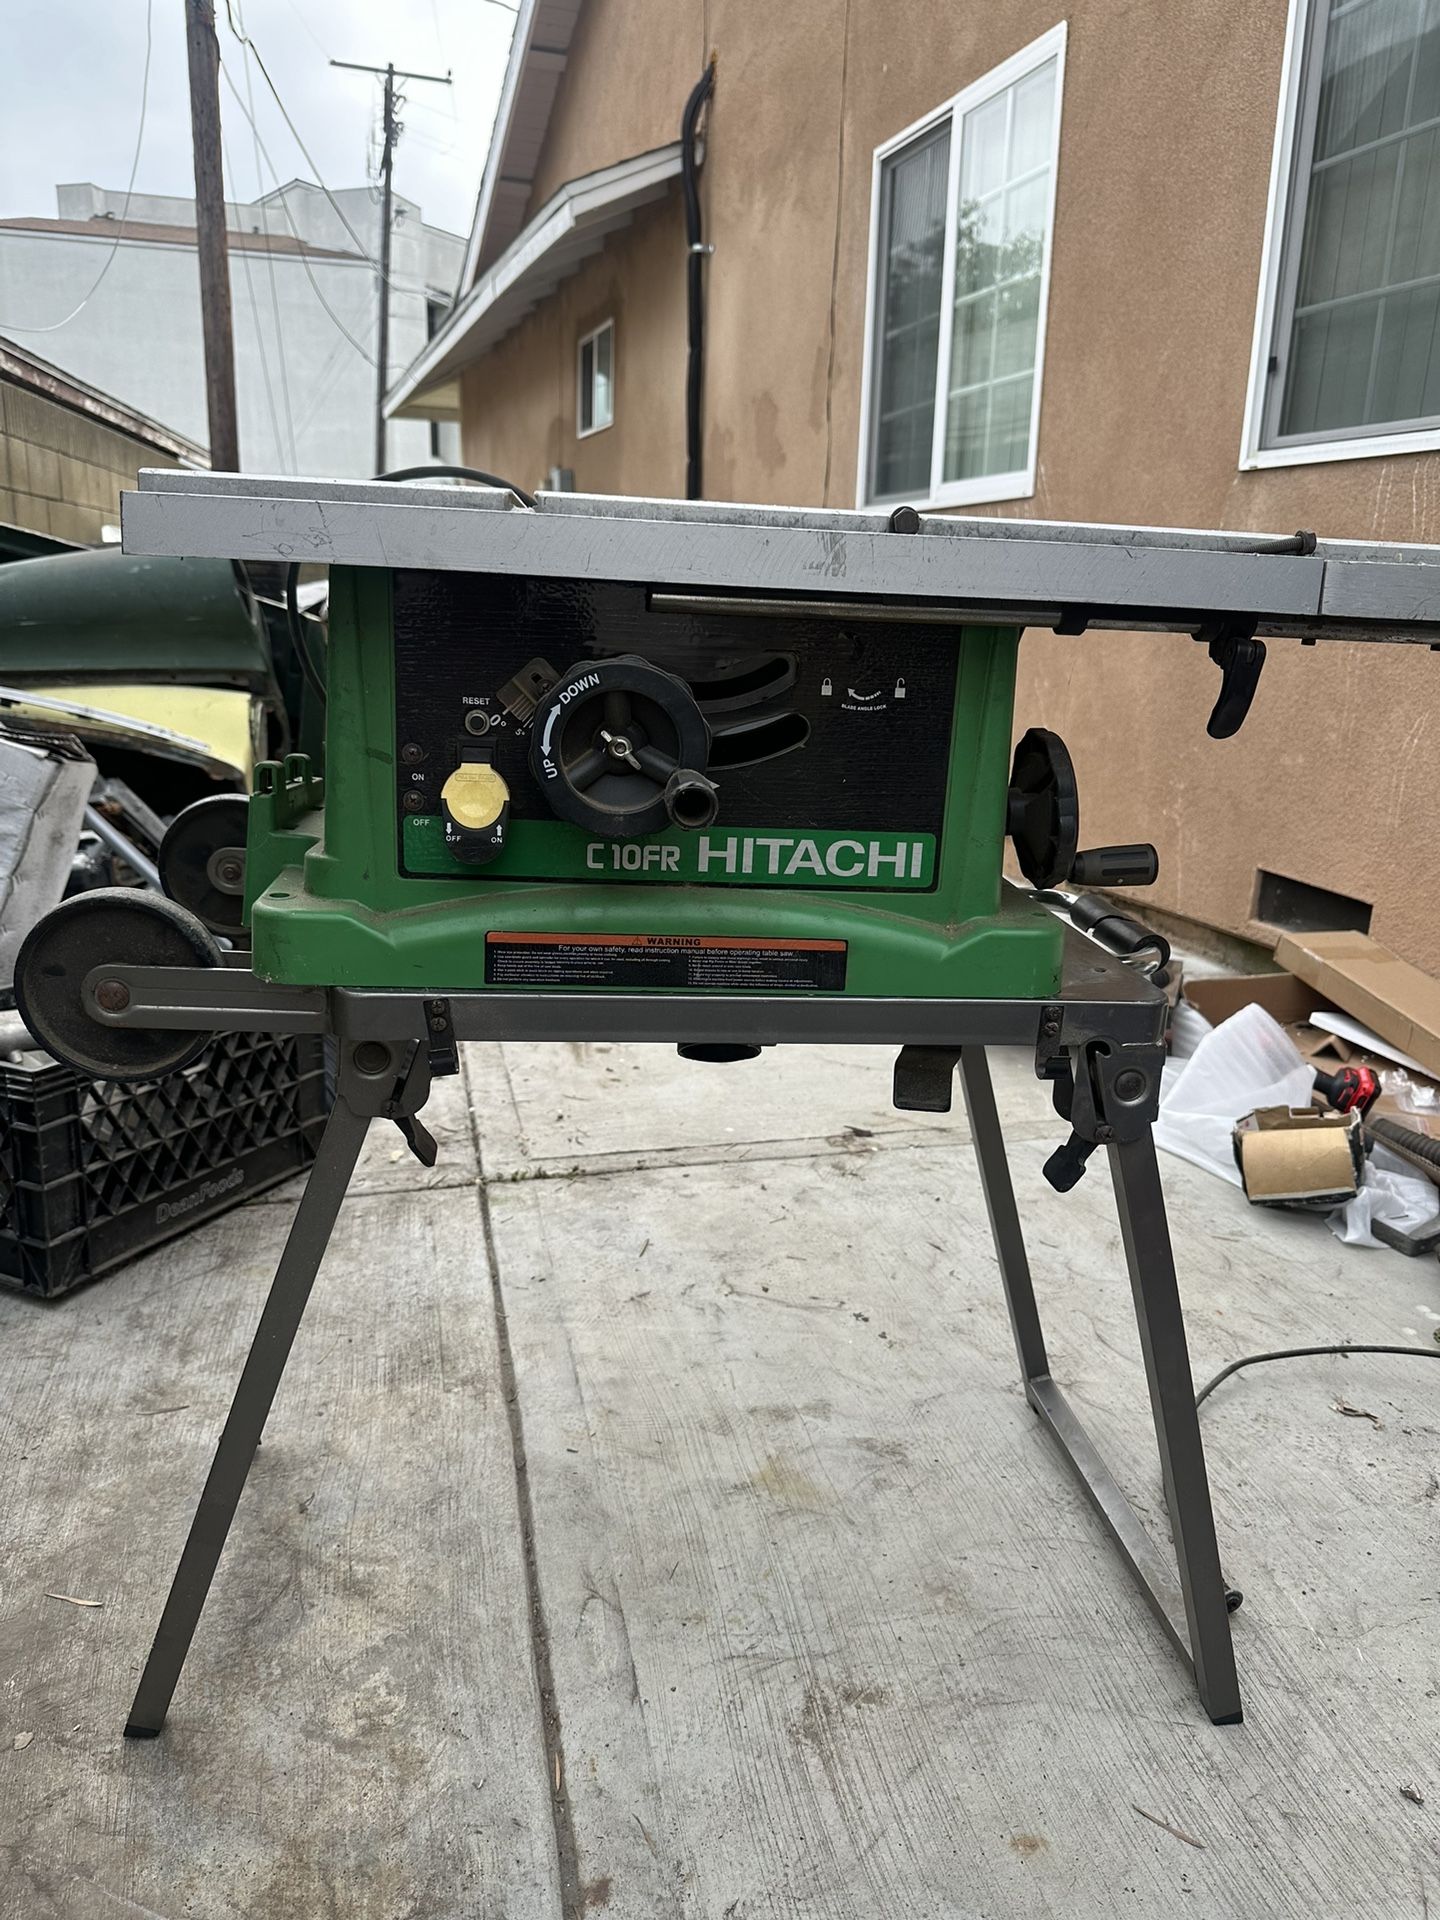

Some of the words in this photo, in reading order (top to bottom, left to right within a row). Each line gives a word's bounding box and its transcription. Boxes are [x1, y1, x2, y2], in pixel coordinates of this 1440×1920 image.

[558, 672, 600, 705] DOWN
[462, 696, 490, 706] RESET
[841, 703, 857, 711] BLADE
[873, 703, 887, 711] LOCK
[544, 759, 558, 780] UP
[412, 772, 425, 781] ON
[413, 818, 430, 827] OFF
[445, 834, 462, 843] OFF
[490, 836, 503, 844] ON
[586, 843, 604, 869] C
[611, 844, 680, 872] 10FR
[697, 835, 923, 878] HITACHI
[647, 937, 701, 947] WARNING
[570, 946, 587, 954] your
[729, 949, 760, 958] operating
[762, 949, 779, 957] table
